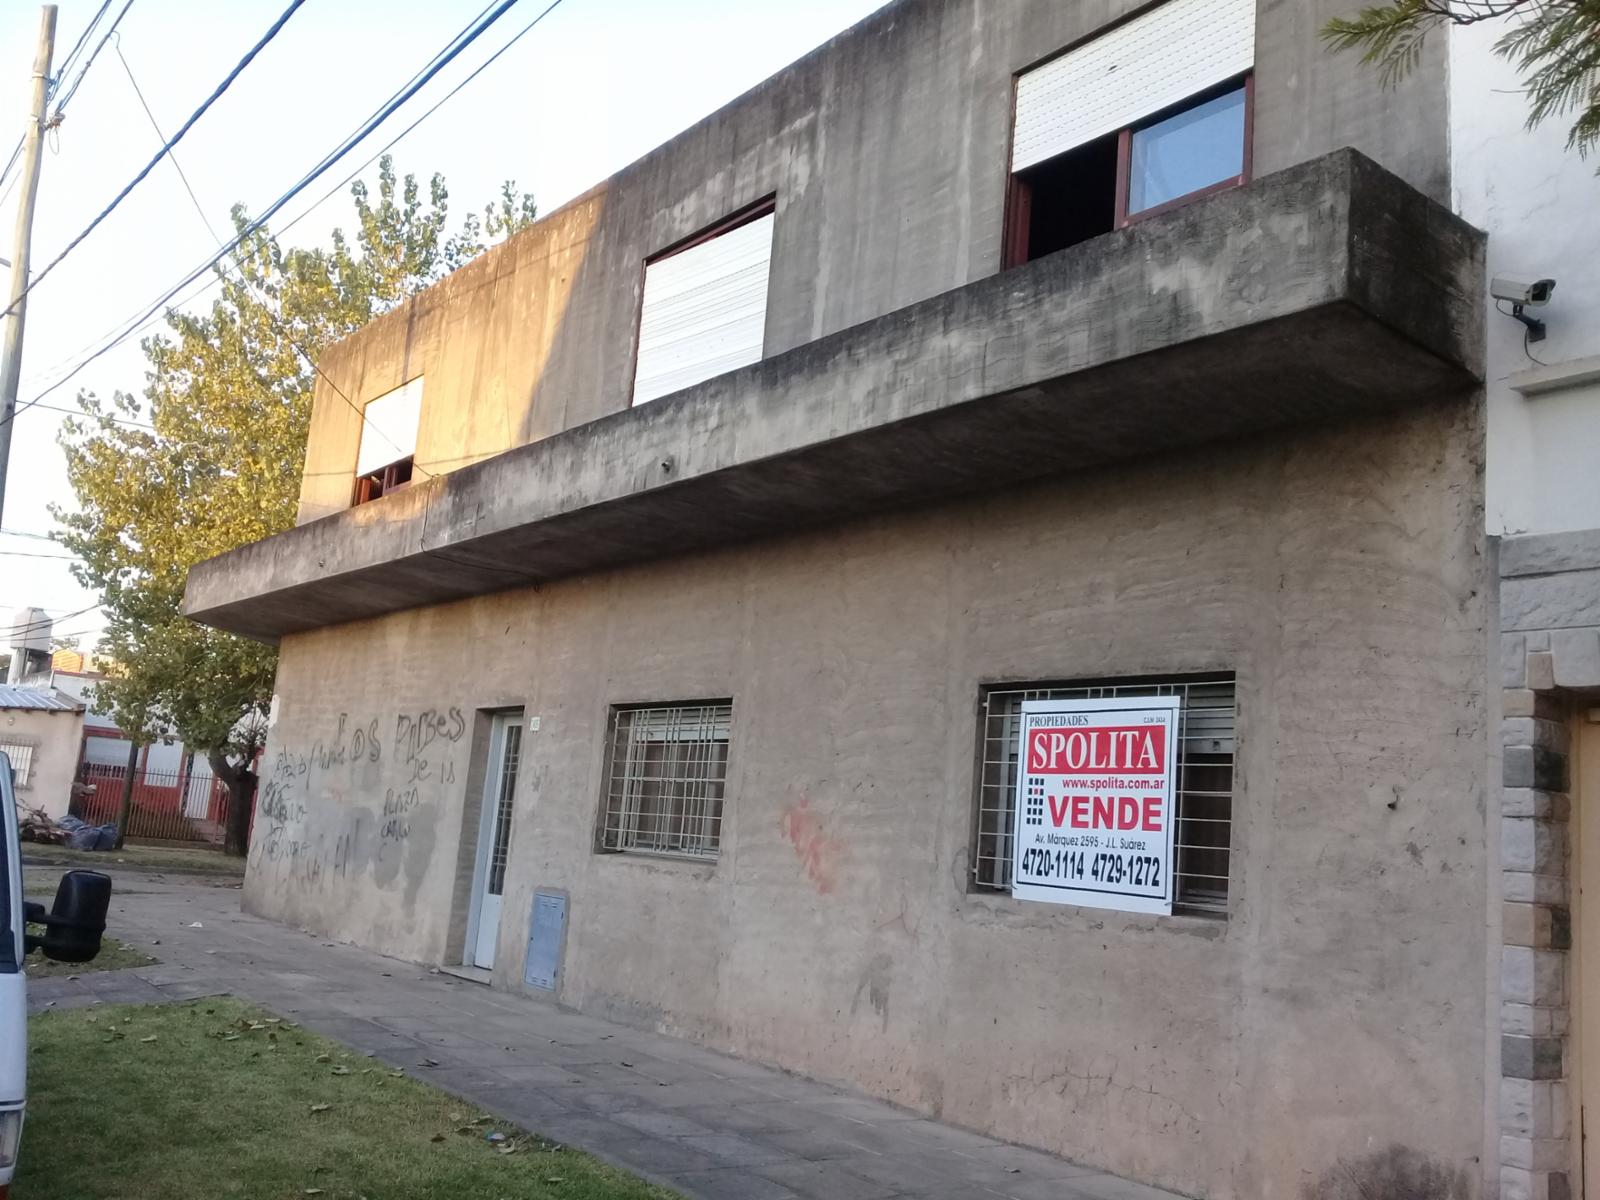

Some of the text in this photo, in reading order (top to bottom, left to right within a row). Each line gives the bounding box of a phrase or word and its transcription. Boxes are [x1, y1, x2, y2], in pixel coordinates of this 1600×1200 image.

[1029, 714, 1089, 727] PROPIEDADES
[1032, 730, 1159, 769] SPOLITA
[1062, 776, 1165, 791] www.spolita.com.ar
[1047, 795, 1163, 832] VENDE
[1035, 833, 1045, 844] Av.
[1047, 833, 1079, 849] Márquez
[1080, 835, 1099, 848] 2595
[1105, 837, 1118, 849] J.L.
[1120, 837, 1146, 851] Suárez
[1022, 847, 1160, 887] 4720-1114 4729-1272
